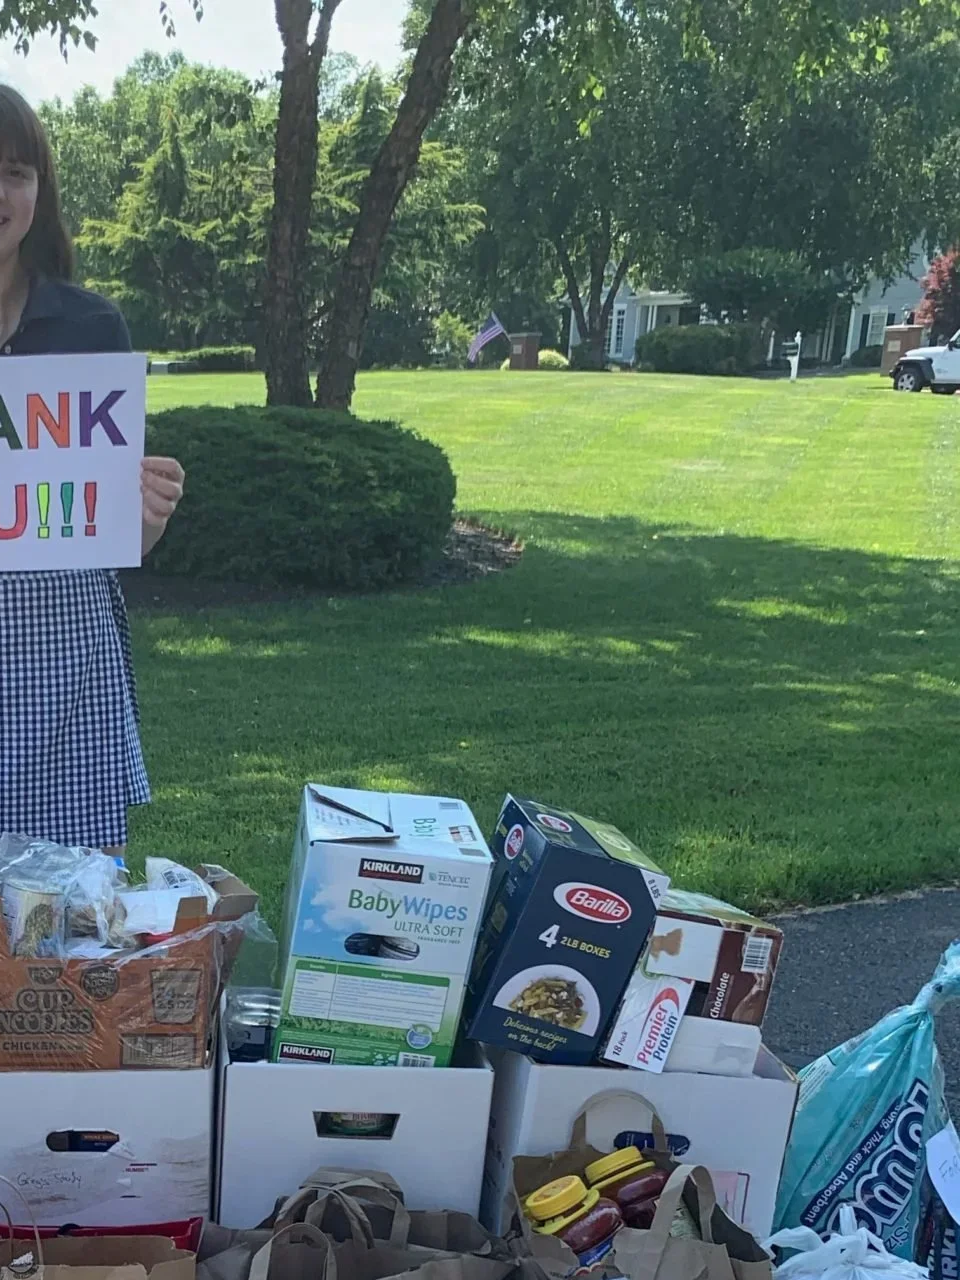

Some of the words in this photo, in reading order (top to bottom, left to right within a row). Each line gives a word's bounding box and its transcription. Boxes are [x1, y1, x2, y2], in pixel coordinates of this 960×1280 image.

[362, 860, 422, 877] KIRKLAND
[570, 890, 625, 918] Barilla
[394, 920, 431, 934] ULTRA
[434, 925, 465, 938] SOFT
[538, 924, 561, 948] 4
[580, 940, 612, 959] BOXES
[16, 988, 75, 1013] CUP
[710, 972, 731, 1019] Chocolate
[503, 1016, 539, 1035] Delicious
[540, 1027, 568, 1044] recipes
[637, 1004, 669, 1066] Premier
[653, 1014, 678, 1061] Protein
[2, 1041, 58, 1051] CHICKEN
[282, 1045, 331, 1058] KIRKLAND
[612, 1046, 623, 1057] 18
[864, 1129, 884, 1155] Thick
[846, 1153, 864, 1174] and
[803, 1172, 849, 1224] Absorbent
